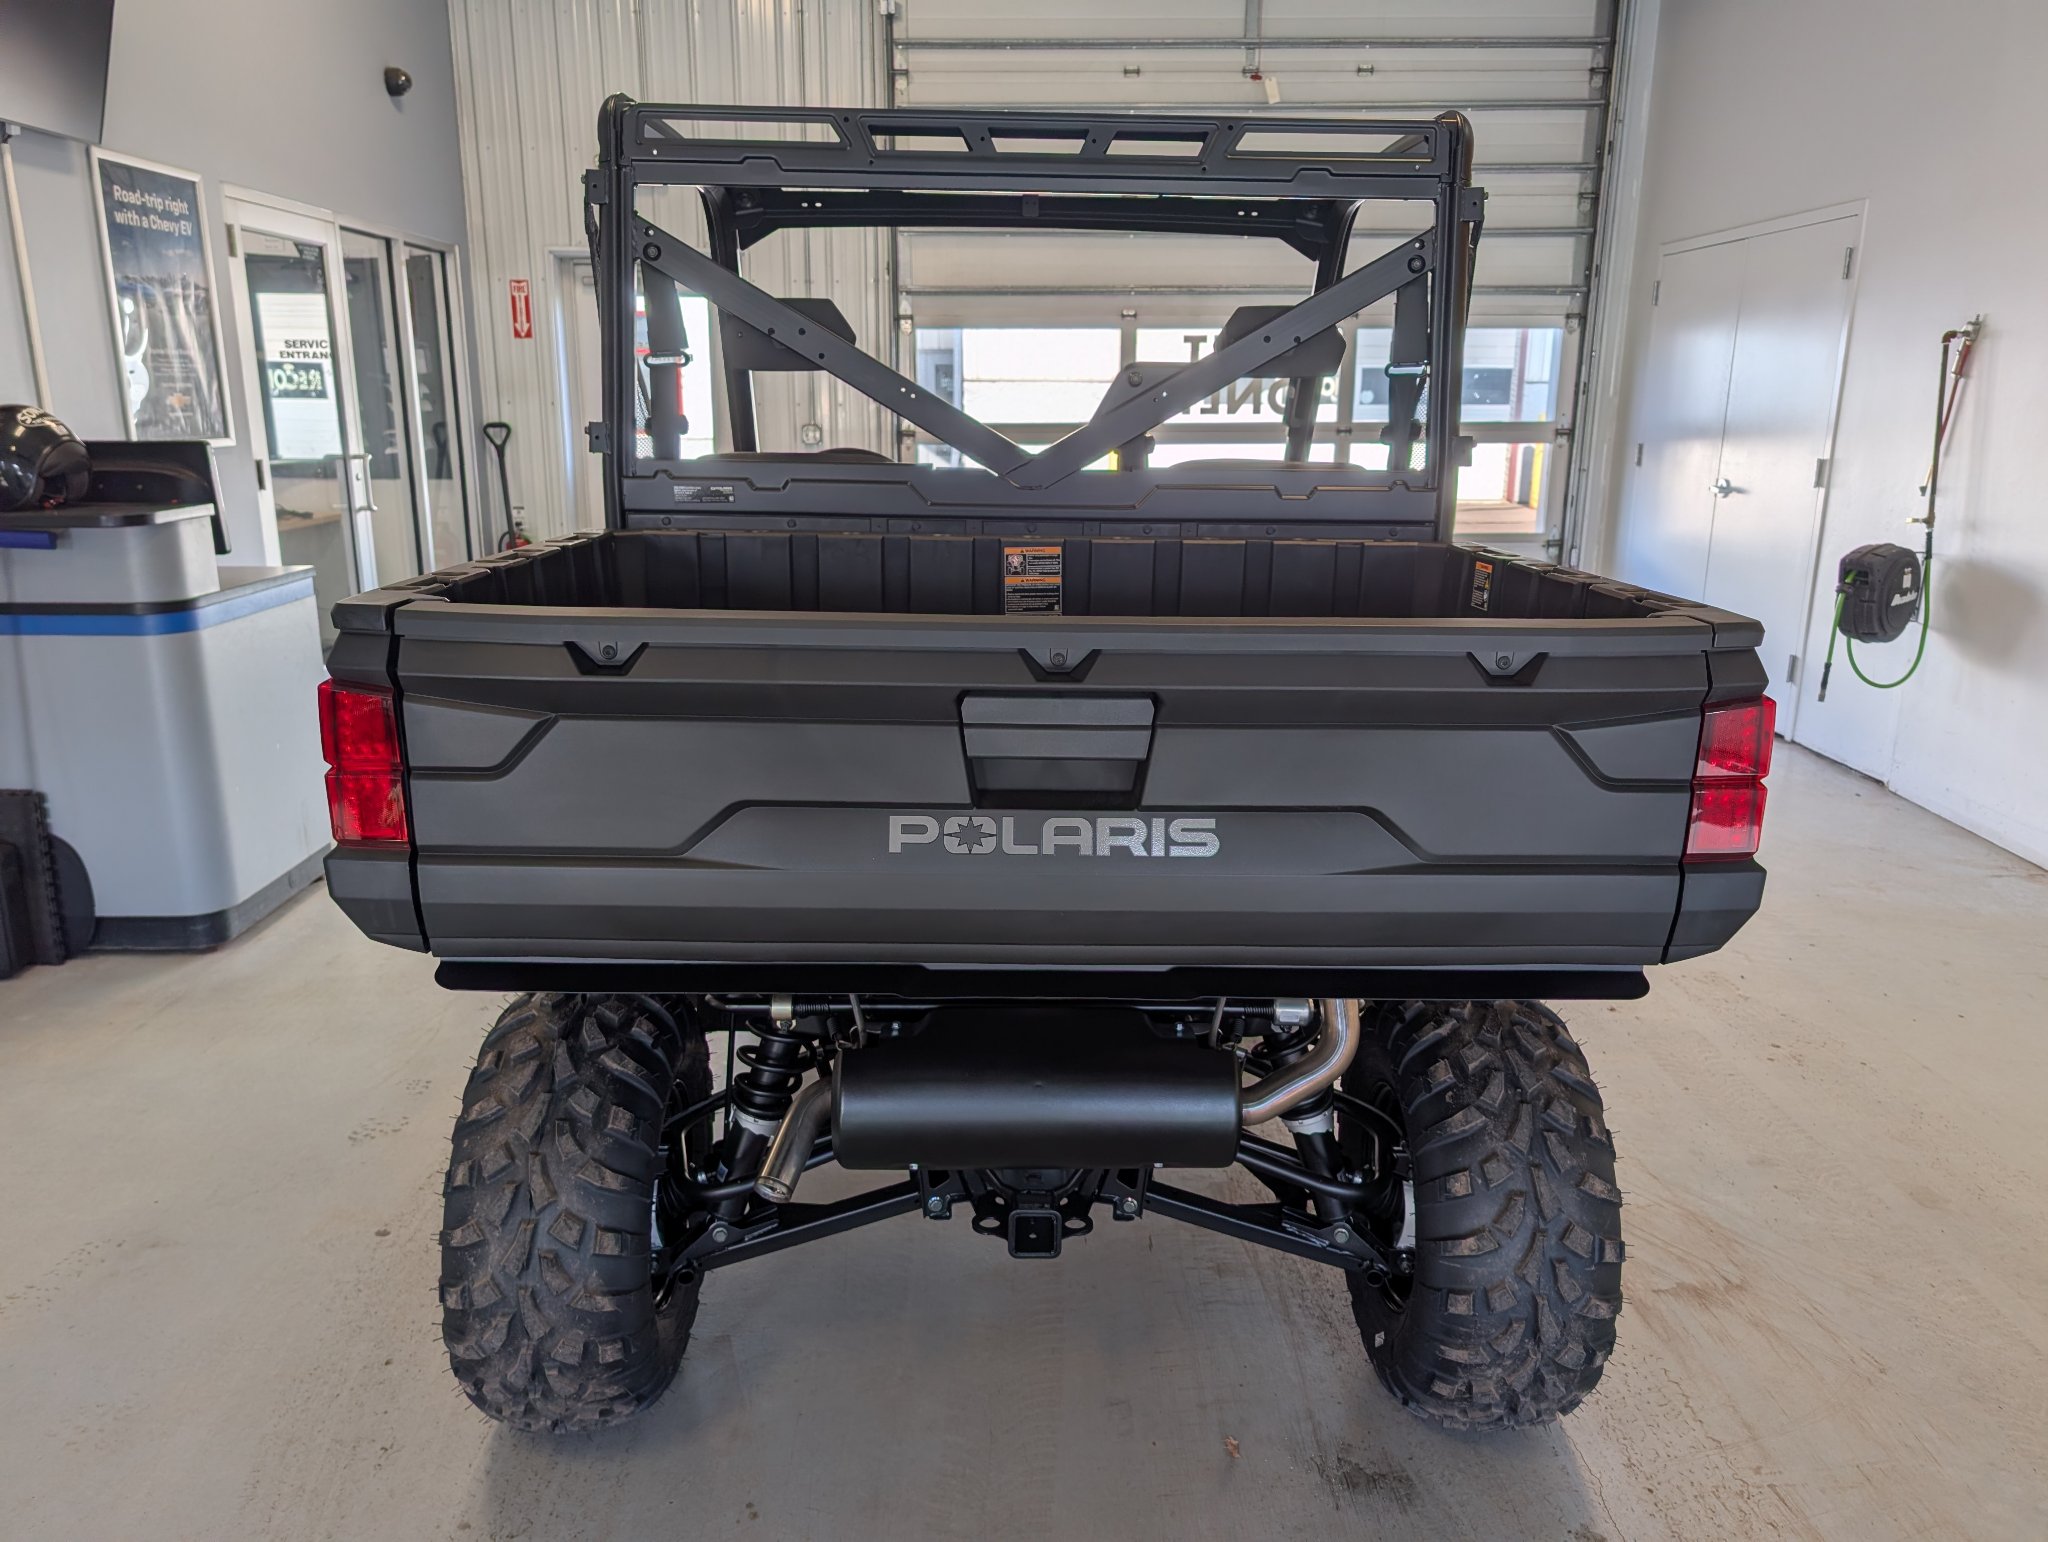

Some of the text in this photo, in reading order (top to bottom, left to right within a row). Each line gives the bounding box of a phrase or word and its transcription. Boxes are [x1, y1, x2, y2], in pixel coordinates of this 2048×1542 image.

[113, 185, 189, 216] Road-trip right
[114, 208, 192, 237] with a Chevy EV
[279, 351, 332, 359] ENTRAN
[284, 339, 328, 349] SERVIC
[888, 815, 1221, 857] POLARIS
